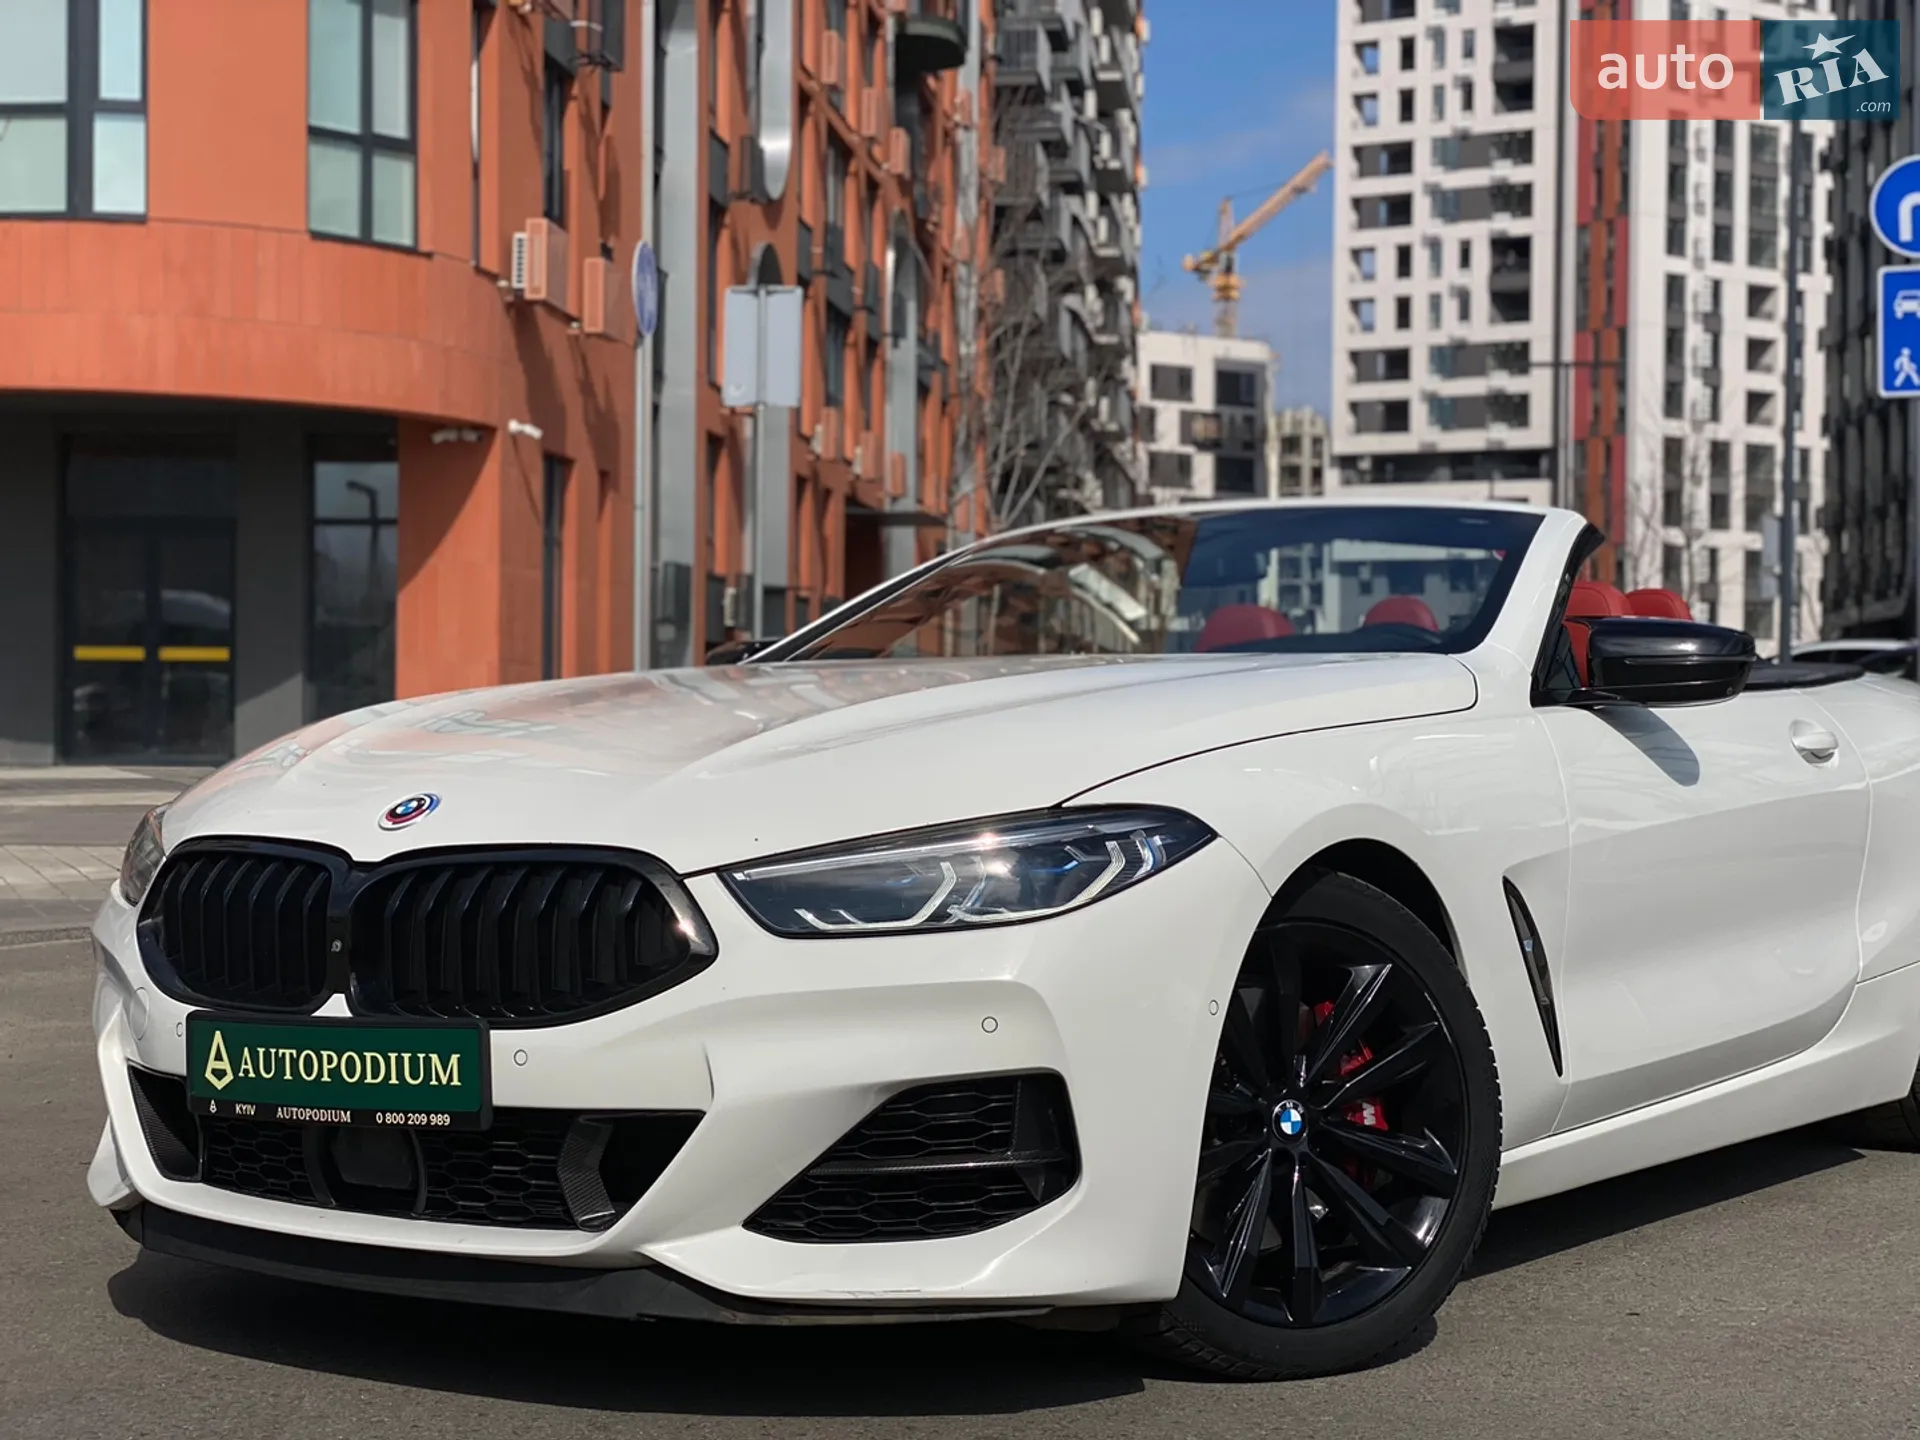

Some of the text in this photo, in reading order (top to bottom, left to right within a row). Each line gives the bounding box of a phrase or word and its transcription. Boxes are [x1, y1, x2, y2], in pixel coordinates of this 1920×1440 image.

[238, 1046, 462, 1086] AUTOPODIUM
[235, 1103, 450, 1126] KYIV AUTOPODIUM 0 800 209 989
